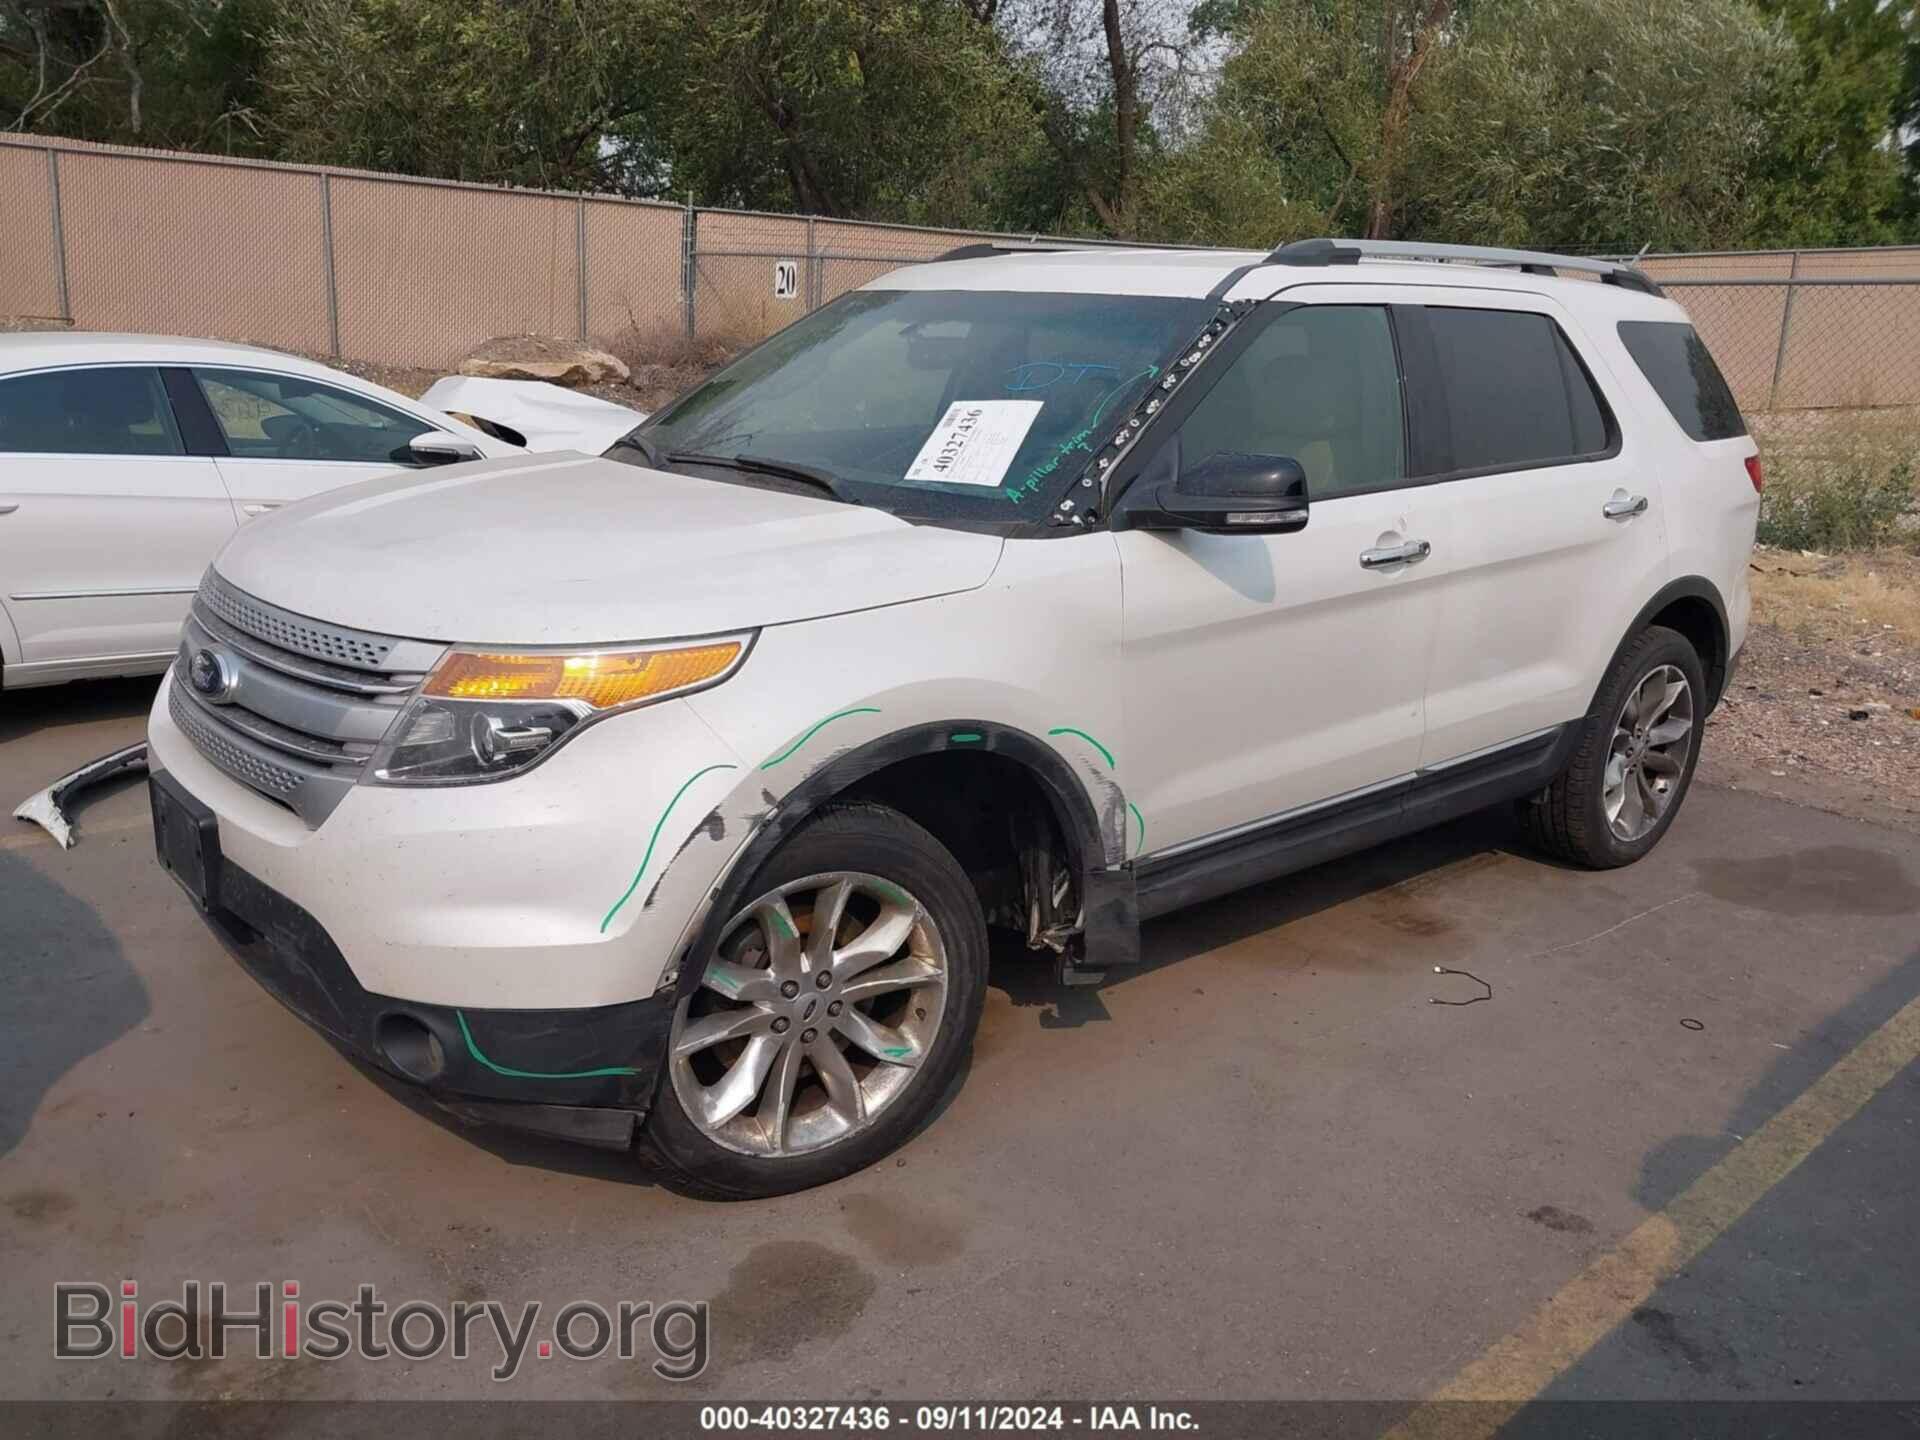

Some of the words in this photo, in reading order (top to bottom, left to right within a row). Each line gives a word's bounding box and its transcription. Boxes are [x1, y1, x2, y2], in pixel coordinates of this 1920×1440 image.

[777, 266, 796, 295] 20
[933, 409, 983, 473] 40327436
[1006, 456, 1060, 504] A-pillar
[1059, 430, 1092, 455] trim
